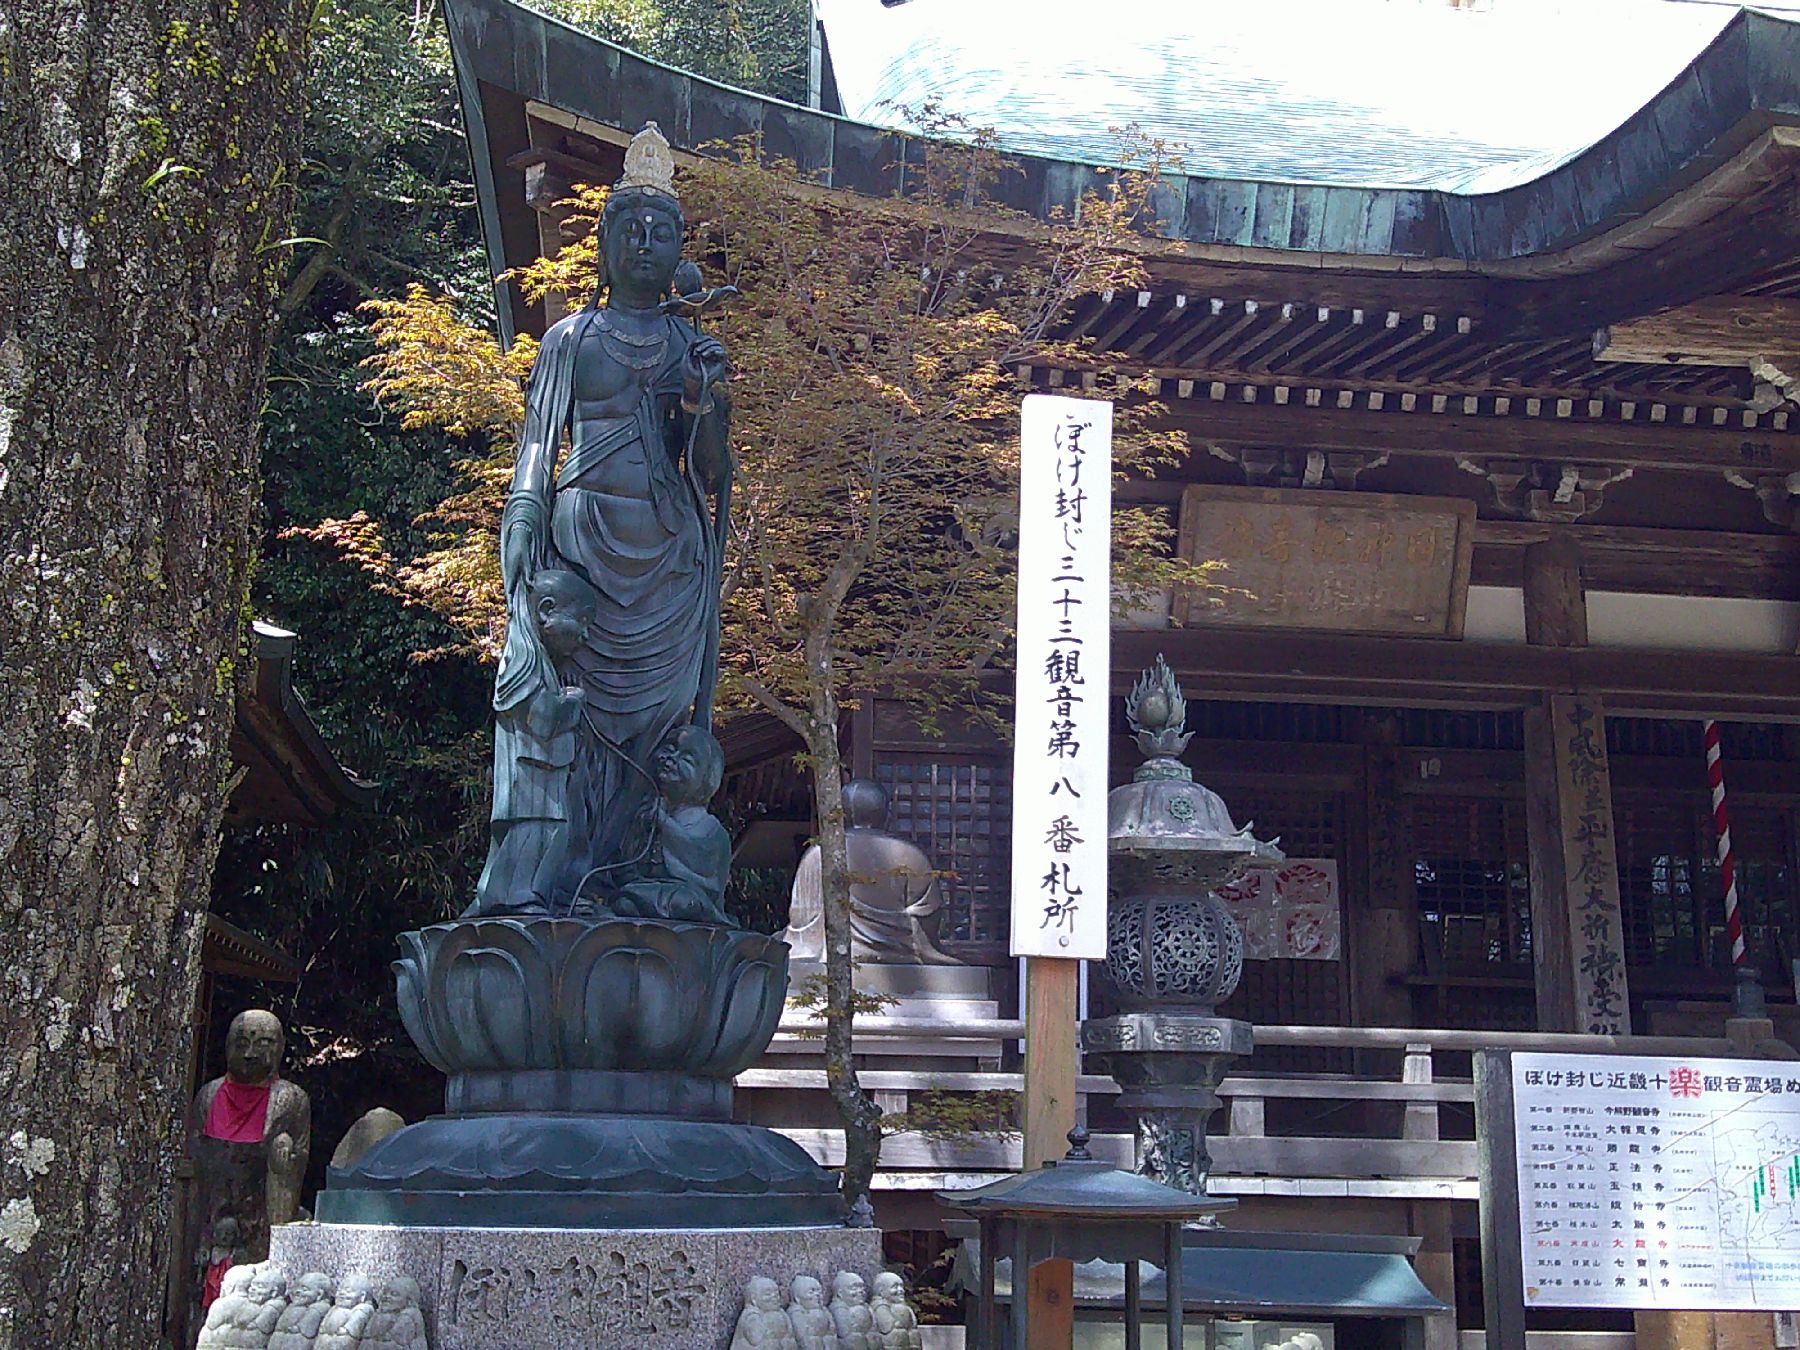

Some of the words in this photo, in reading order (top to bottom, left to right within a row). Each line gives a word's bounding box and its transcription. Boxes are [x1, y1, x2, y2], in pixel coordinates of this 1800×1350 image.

[1040, 415, 1093, 934] ぼけ封じ三十三観音第八番札所
